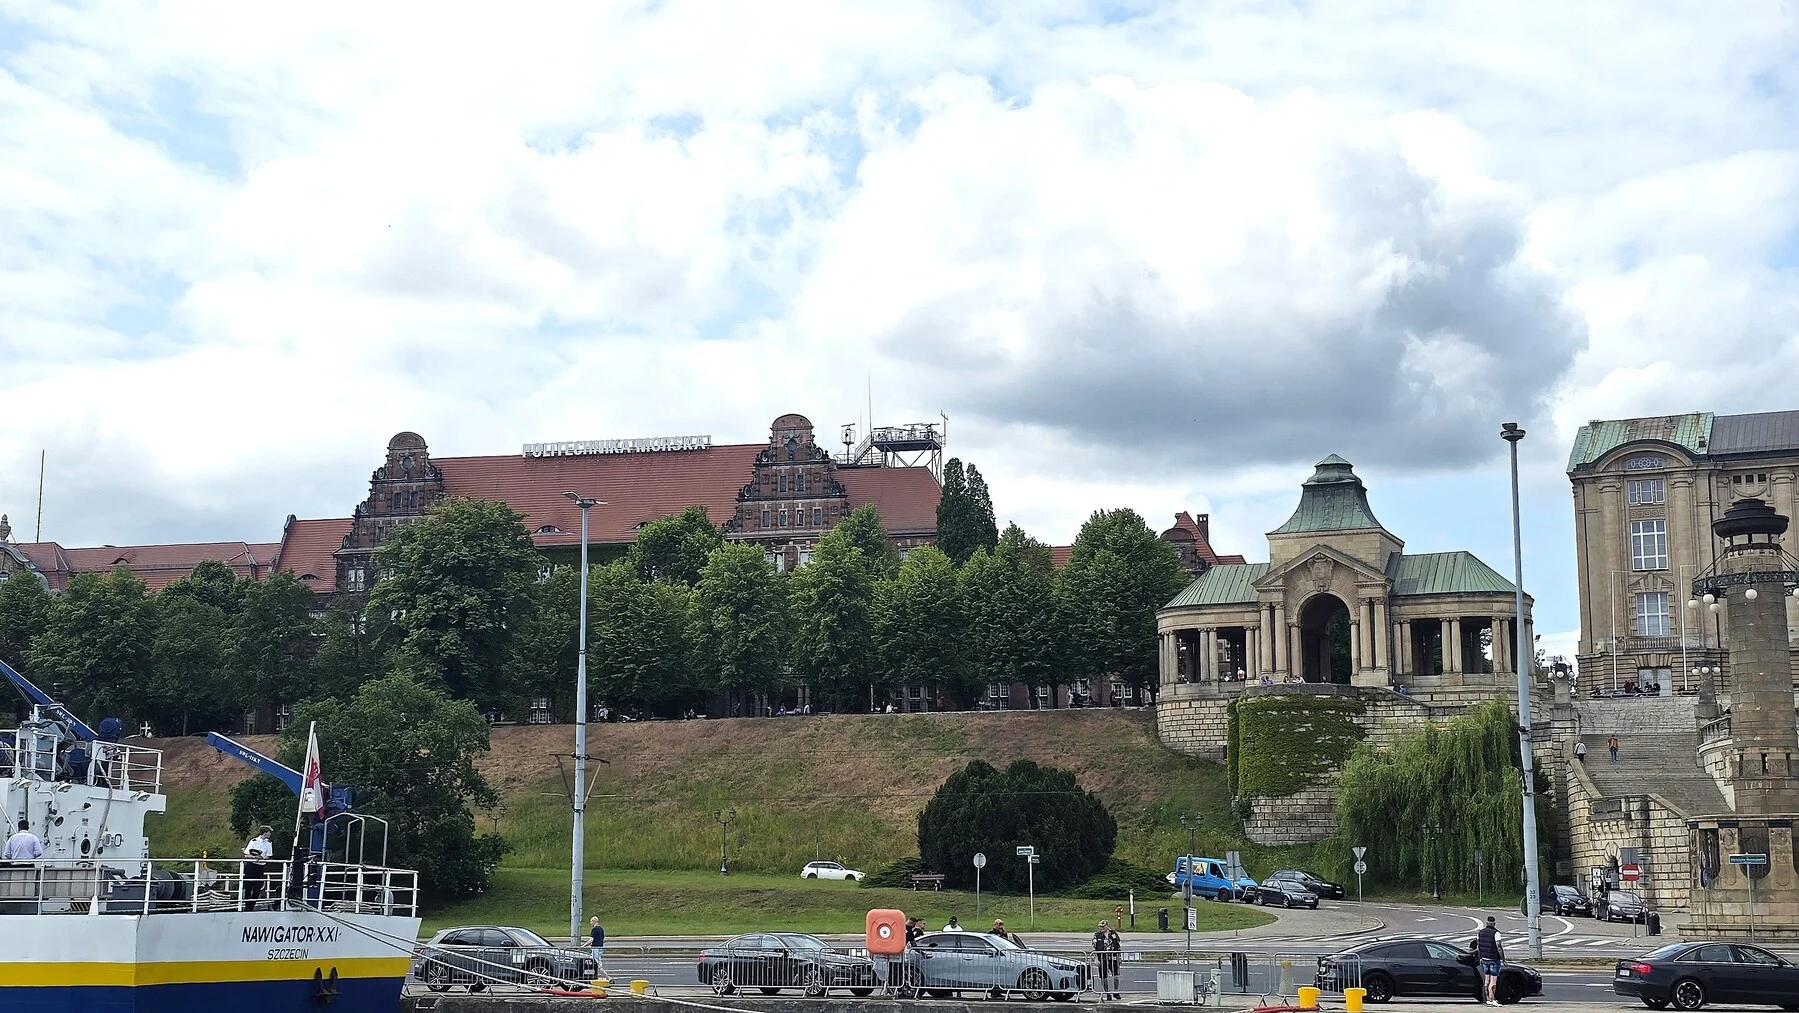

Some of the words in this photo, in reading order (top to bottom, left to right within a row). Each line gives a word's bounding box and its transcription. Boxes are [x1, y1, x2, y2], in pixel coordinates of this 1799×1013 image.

[522, 439, 631, 458] POLITECHNIKA
[637, 435, 706, 453] MORSKA
[241, 925, 314, 943] NAWIGATOR
[267, 948, 310, 960] SZCZECIN
